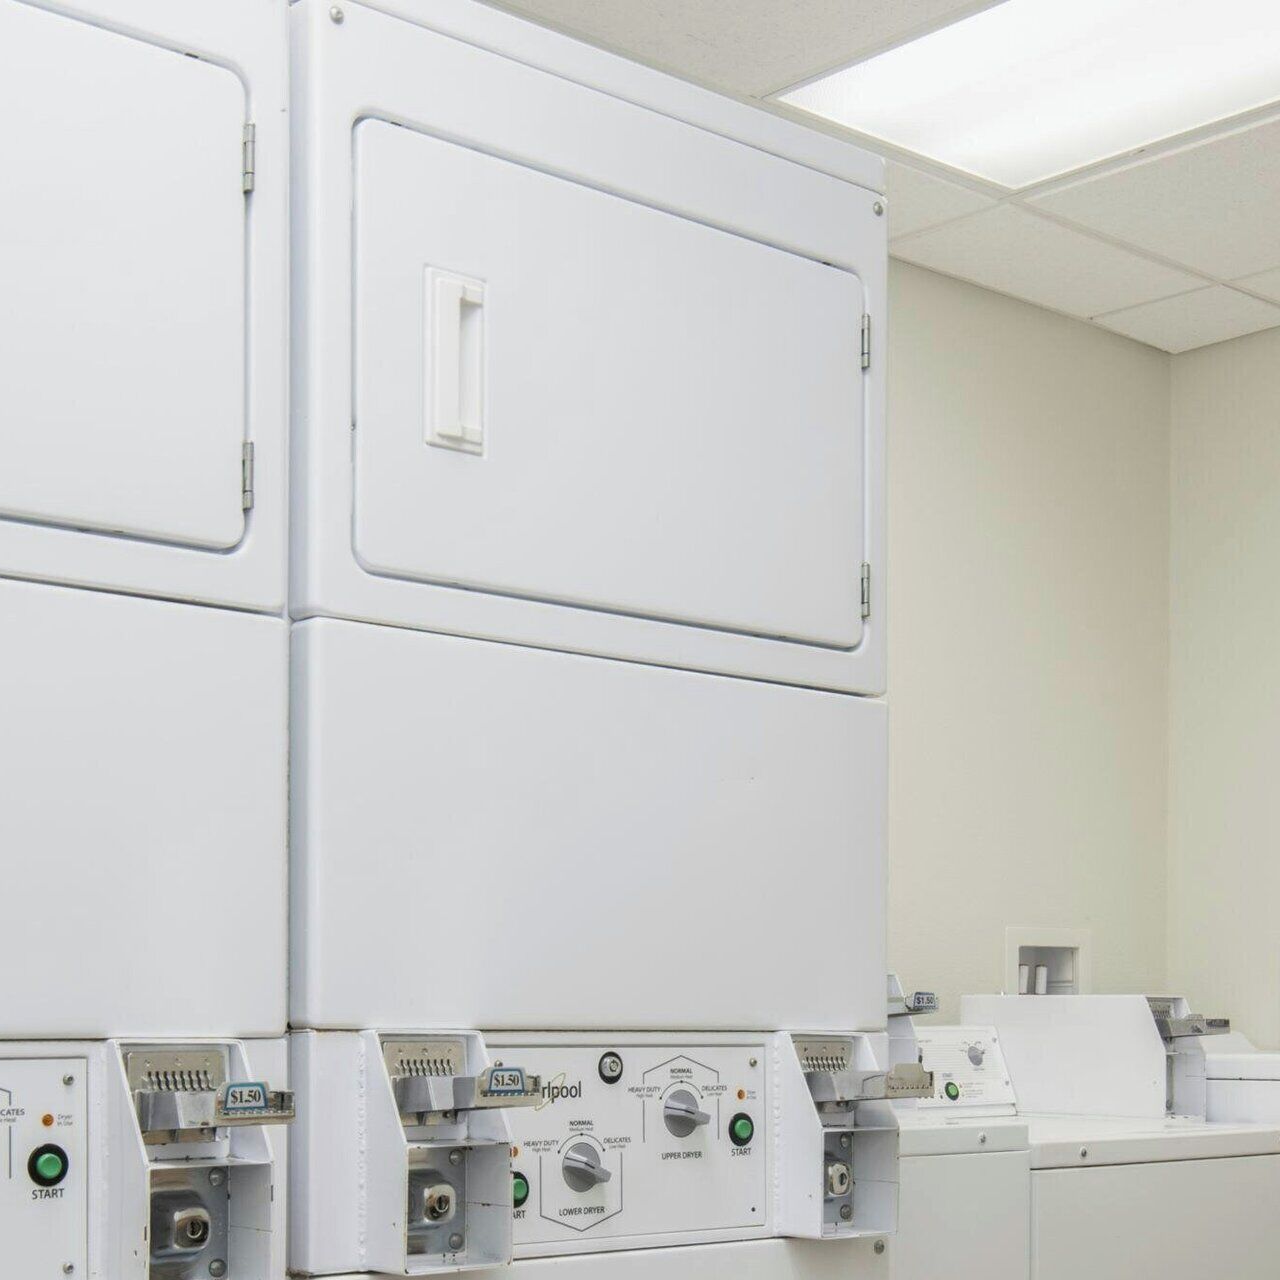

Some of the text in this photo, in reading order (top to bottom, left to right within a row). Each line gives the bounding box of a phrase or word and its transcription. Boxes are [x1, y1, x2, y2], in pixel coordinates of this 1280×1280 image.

[915, 996, 933, 1005] $1.50
[670, 1067, 693, 1075] NORMAL
[494, 1074, 519, 1087] $1.50
[231, 1089, 261, 1104] $1.50
[662, 1150, 702, 1160] UPPER DRYER
[731, 1148, 751, 1157] START
[31, 1188, 65, 1200] START
[559, 1206, 605, 1217] LOWER DRYER
